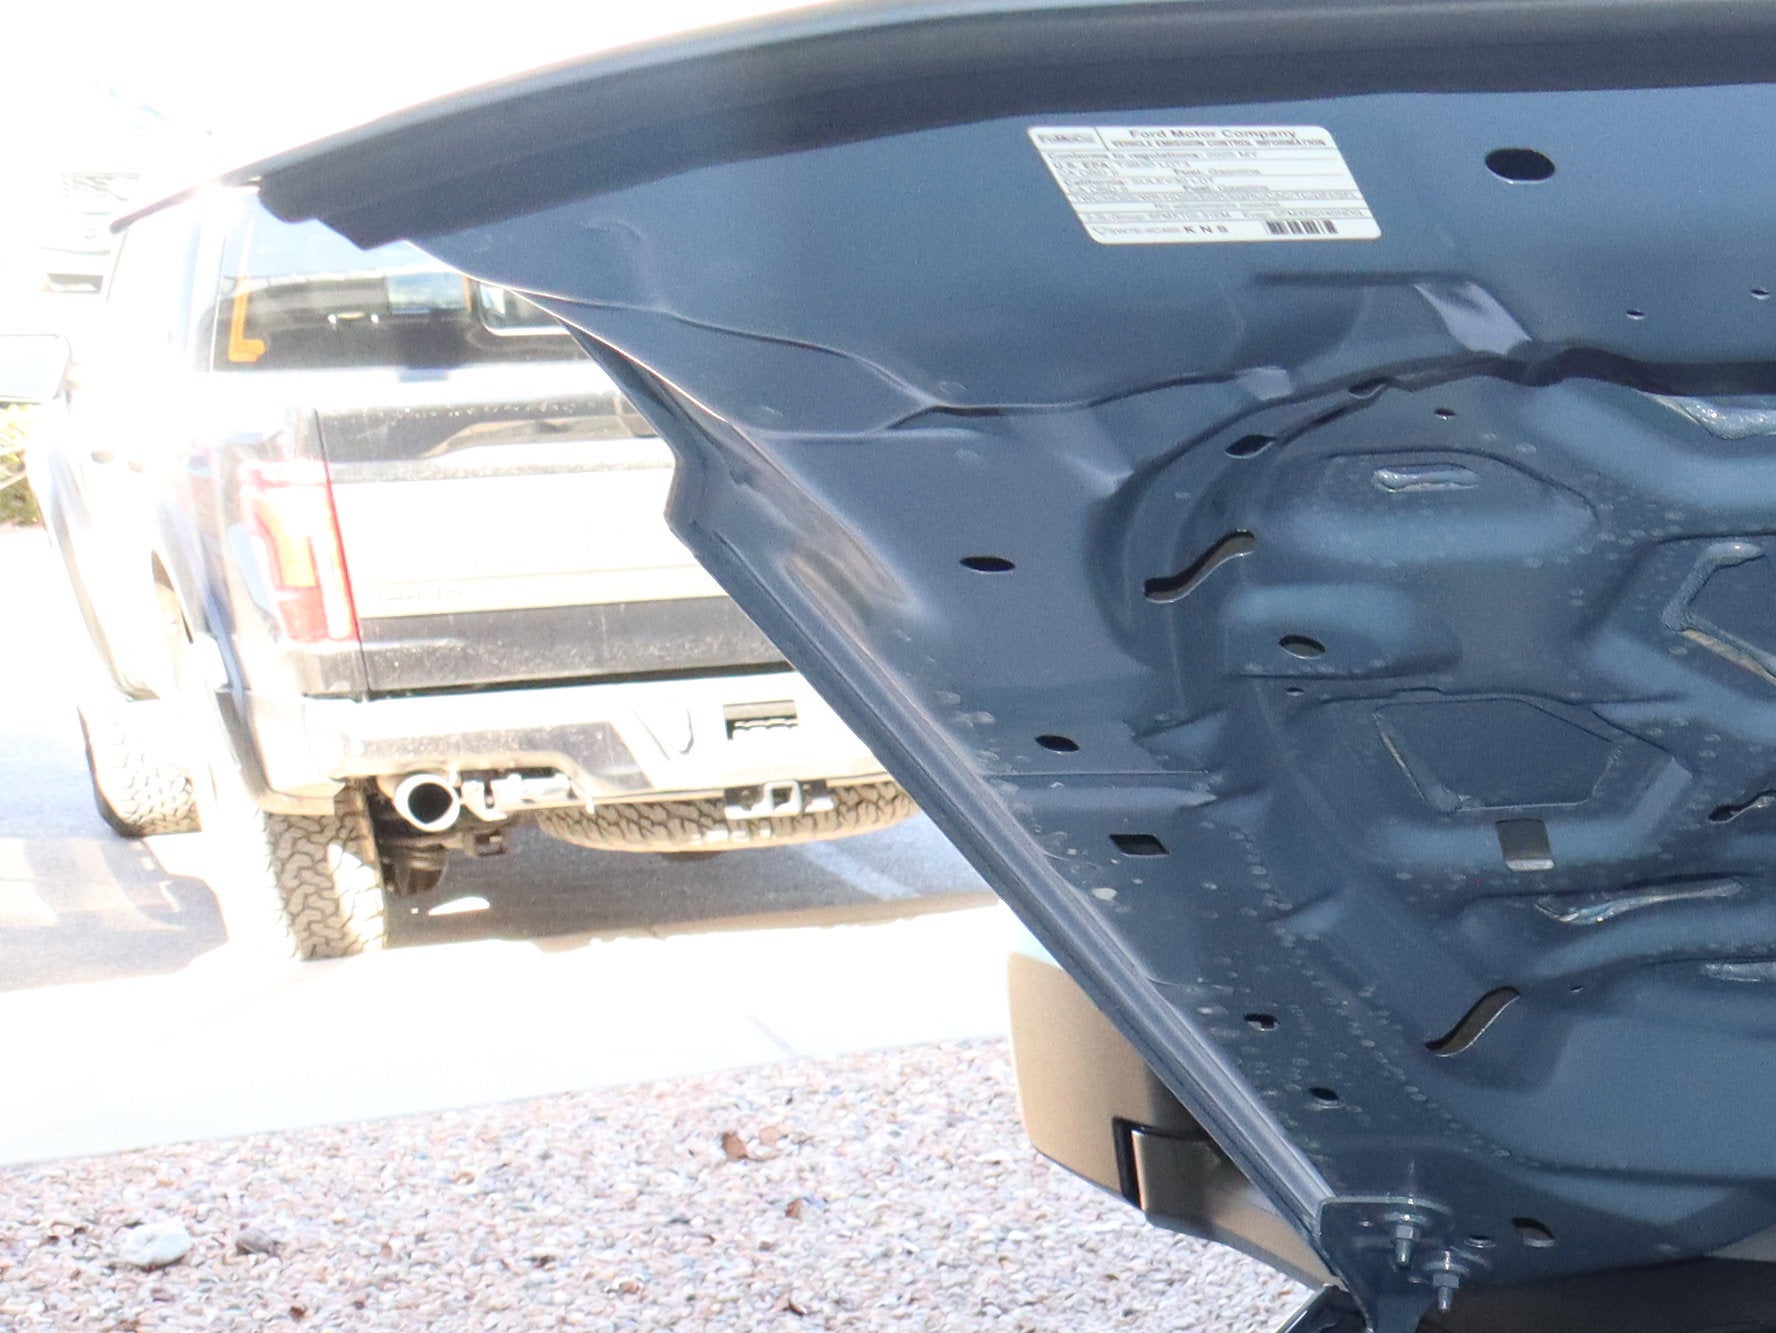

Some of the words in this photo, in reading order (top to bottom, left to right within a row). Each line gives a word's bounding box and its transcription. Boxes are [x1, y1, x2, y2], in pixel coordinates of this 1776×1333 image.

[1129, 129, 1167, 139] Ford
[1171, 129, 1219, 139] Motor
[1222, 129, 1298, 142] Company
